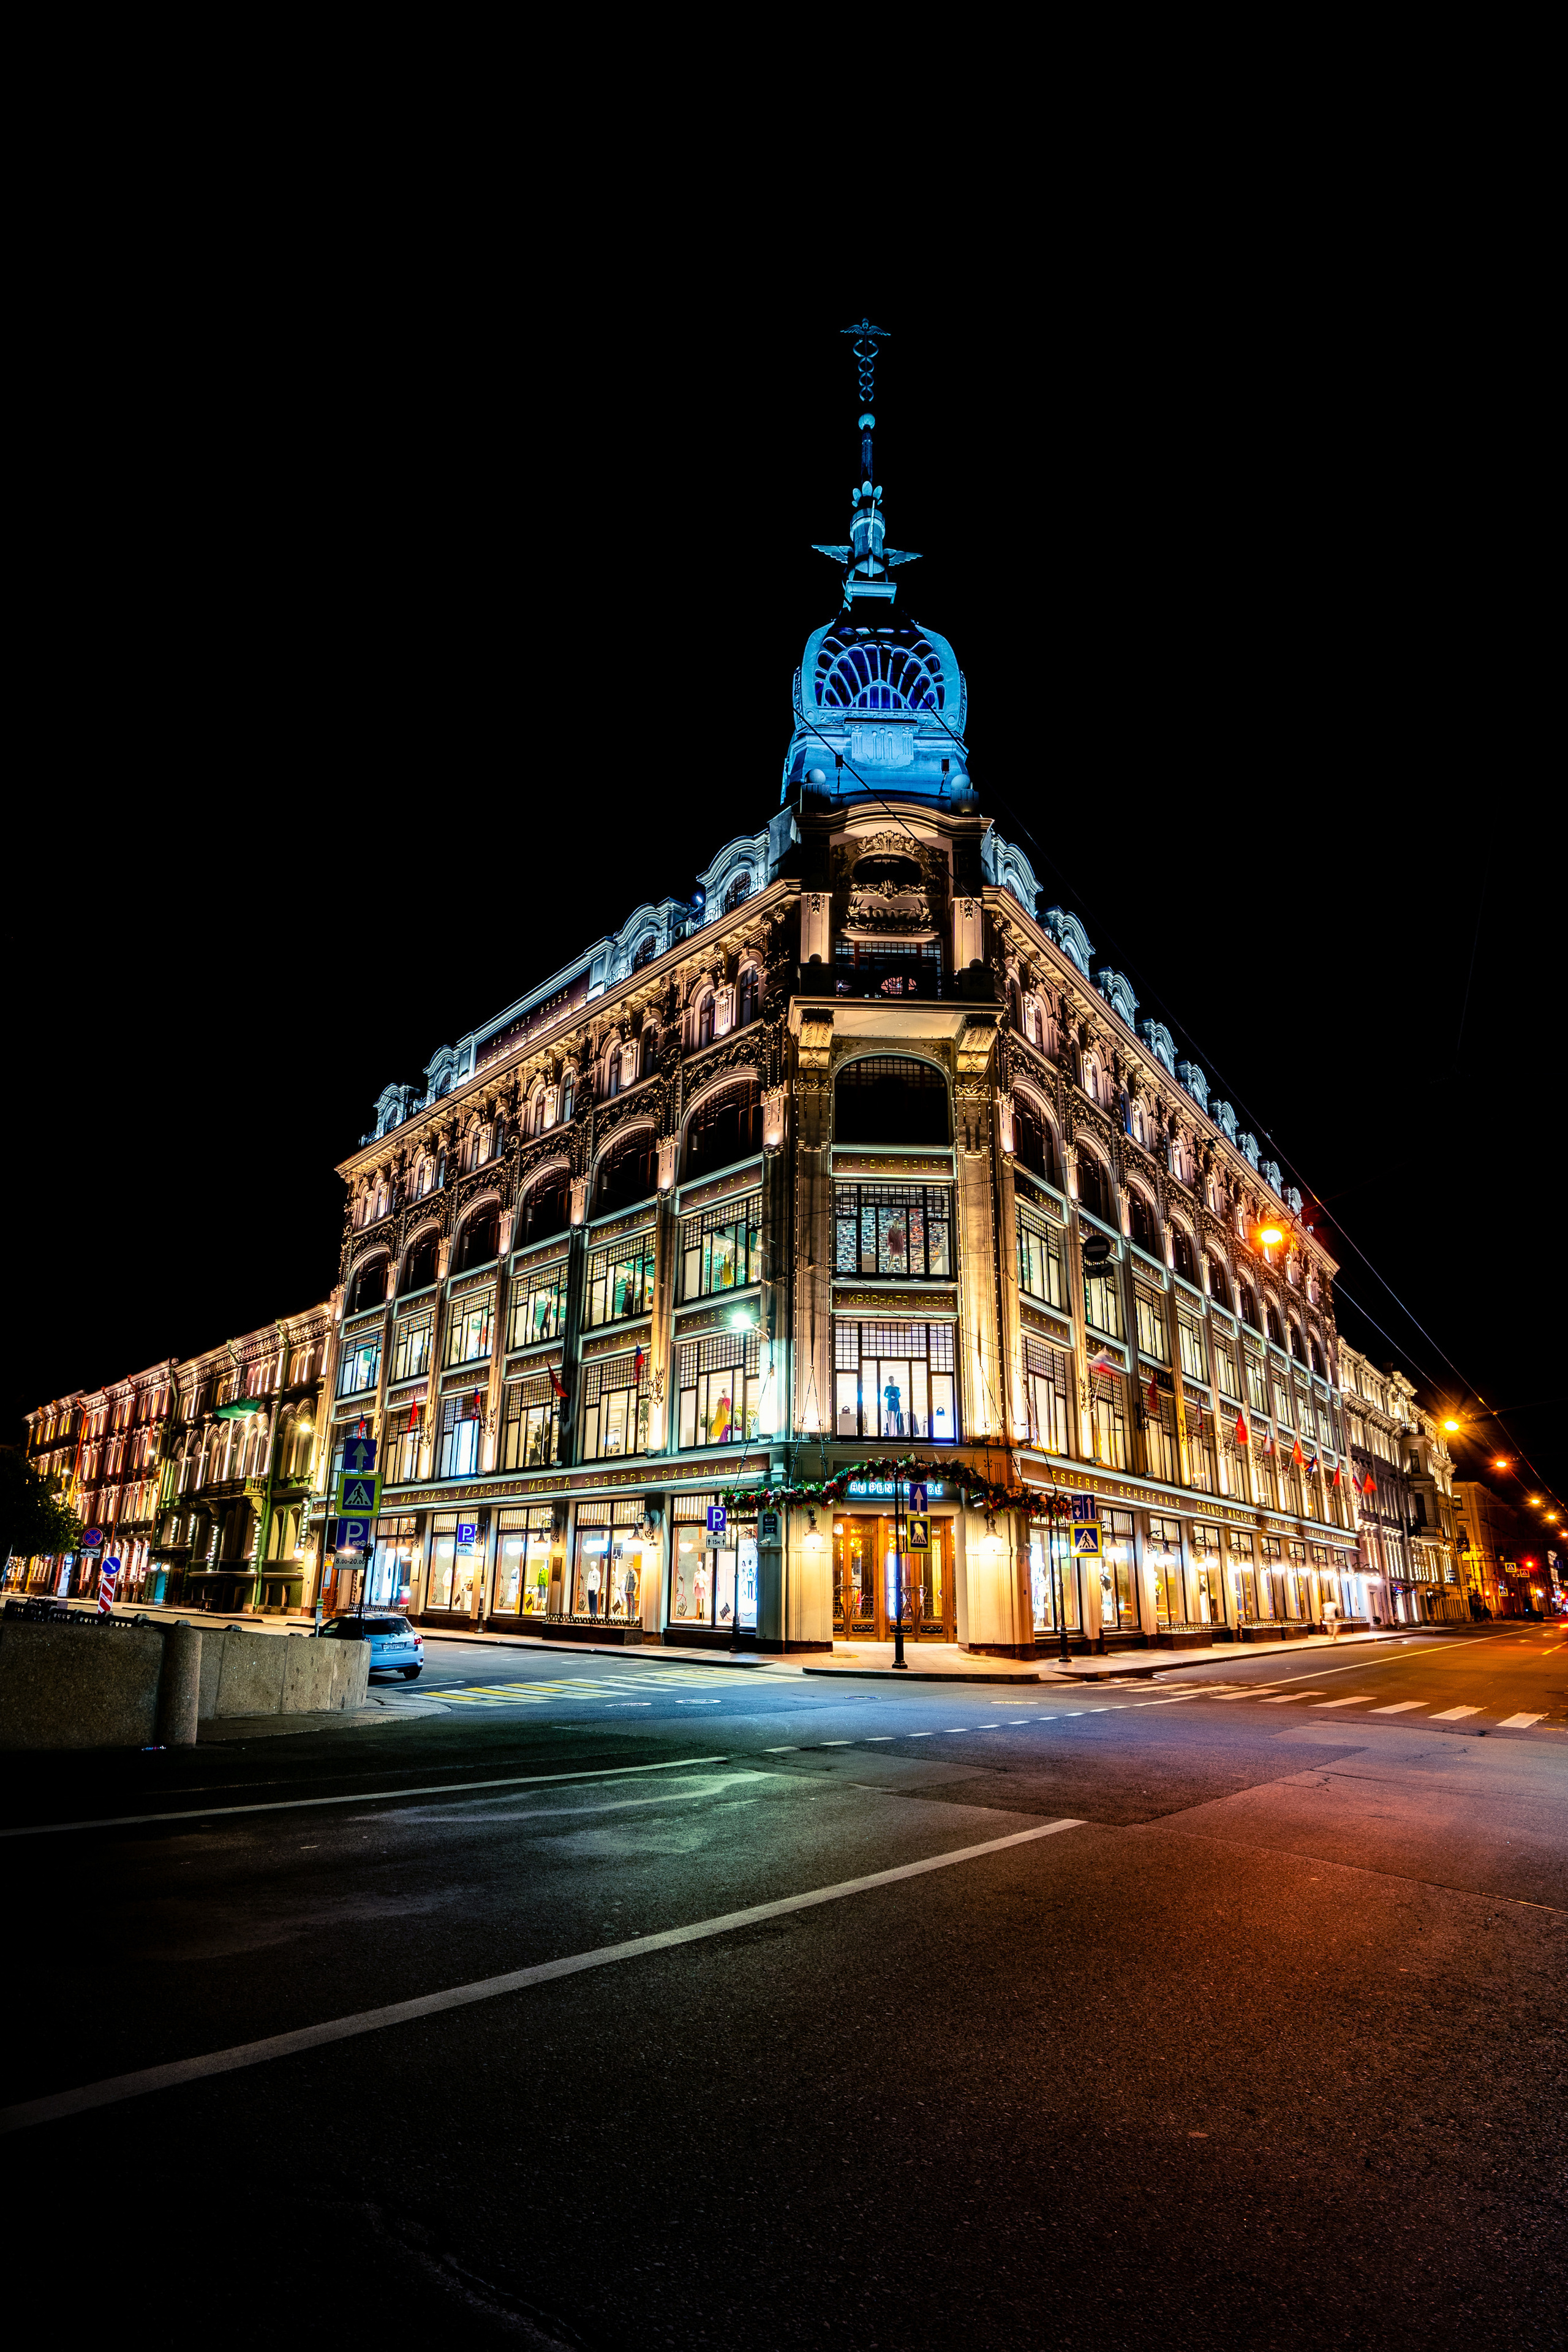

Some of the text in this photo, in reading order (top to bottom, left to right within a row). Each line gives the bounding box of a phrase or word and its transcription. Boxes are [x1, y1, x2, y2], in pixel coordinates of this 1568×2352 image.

[492, 990, 567, 1046] AU PONT ROUGE
[475, 1043, 510, 1072] ESDERS
[521, 992, 587, 1042] SCHEEFHALS
[837, 1158, 948, 1170] AU PONT ROUGE
[835, 1293, 955, 1306] У КРАСНАГО МОСТА
[589, 1330, 646, 1352] GANTERIE
[1086, 1338, 1123, 1364] СОРЧКИ
[511, 1352, 559, 1371] CHAPEAUX
[447, 1371, 485, 1387] LINGERIE
[393, 1386, 424, 1401] FOURRURES
[584, 1472, 647, 1488] ЭСДЕРСЪ
[662, 1461, 757, 1480] СХЕФАЛЬСЪ
[400, 1489, 449, 1504] МАГАЗИНЪ
[455, 1488, 460, 1499] У
[465, 1482, 522, 1498] КРАСНАГО
[528, 1477, 571, 1493] МОСТА
[850, 1482, 867, 1493] AU
[903, 1483, 943, 1495] RGE
[1052, 1471, 1180, 1508] ESDERS ET SCHEEFHALS
[1197, 1501, 1223, 1517] GRANDS
[1227, 1508, 1256, 1525] MAGASINS
[1268, 1518, 1282, 1529] PONT
[1284, 1521, 1300, 1534] ROUGE
[1308, 1529, 1325, 1539] ESDERS
[1332, 1534, 1355, 1546] SCHEEFHALS
